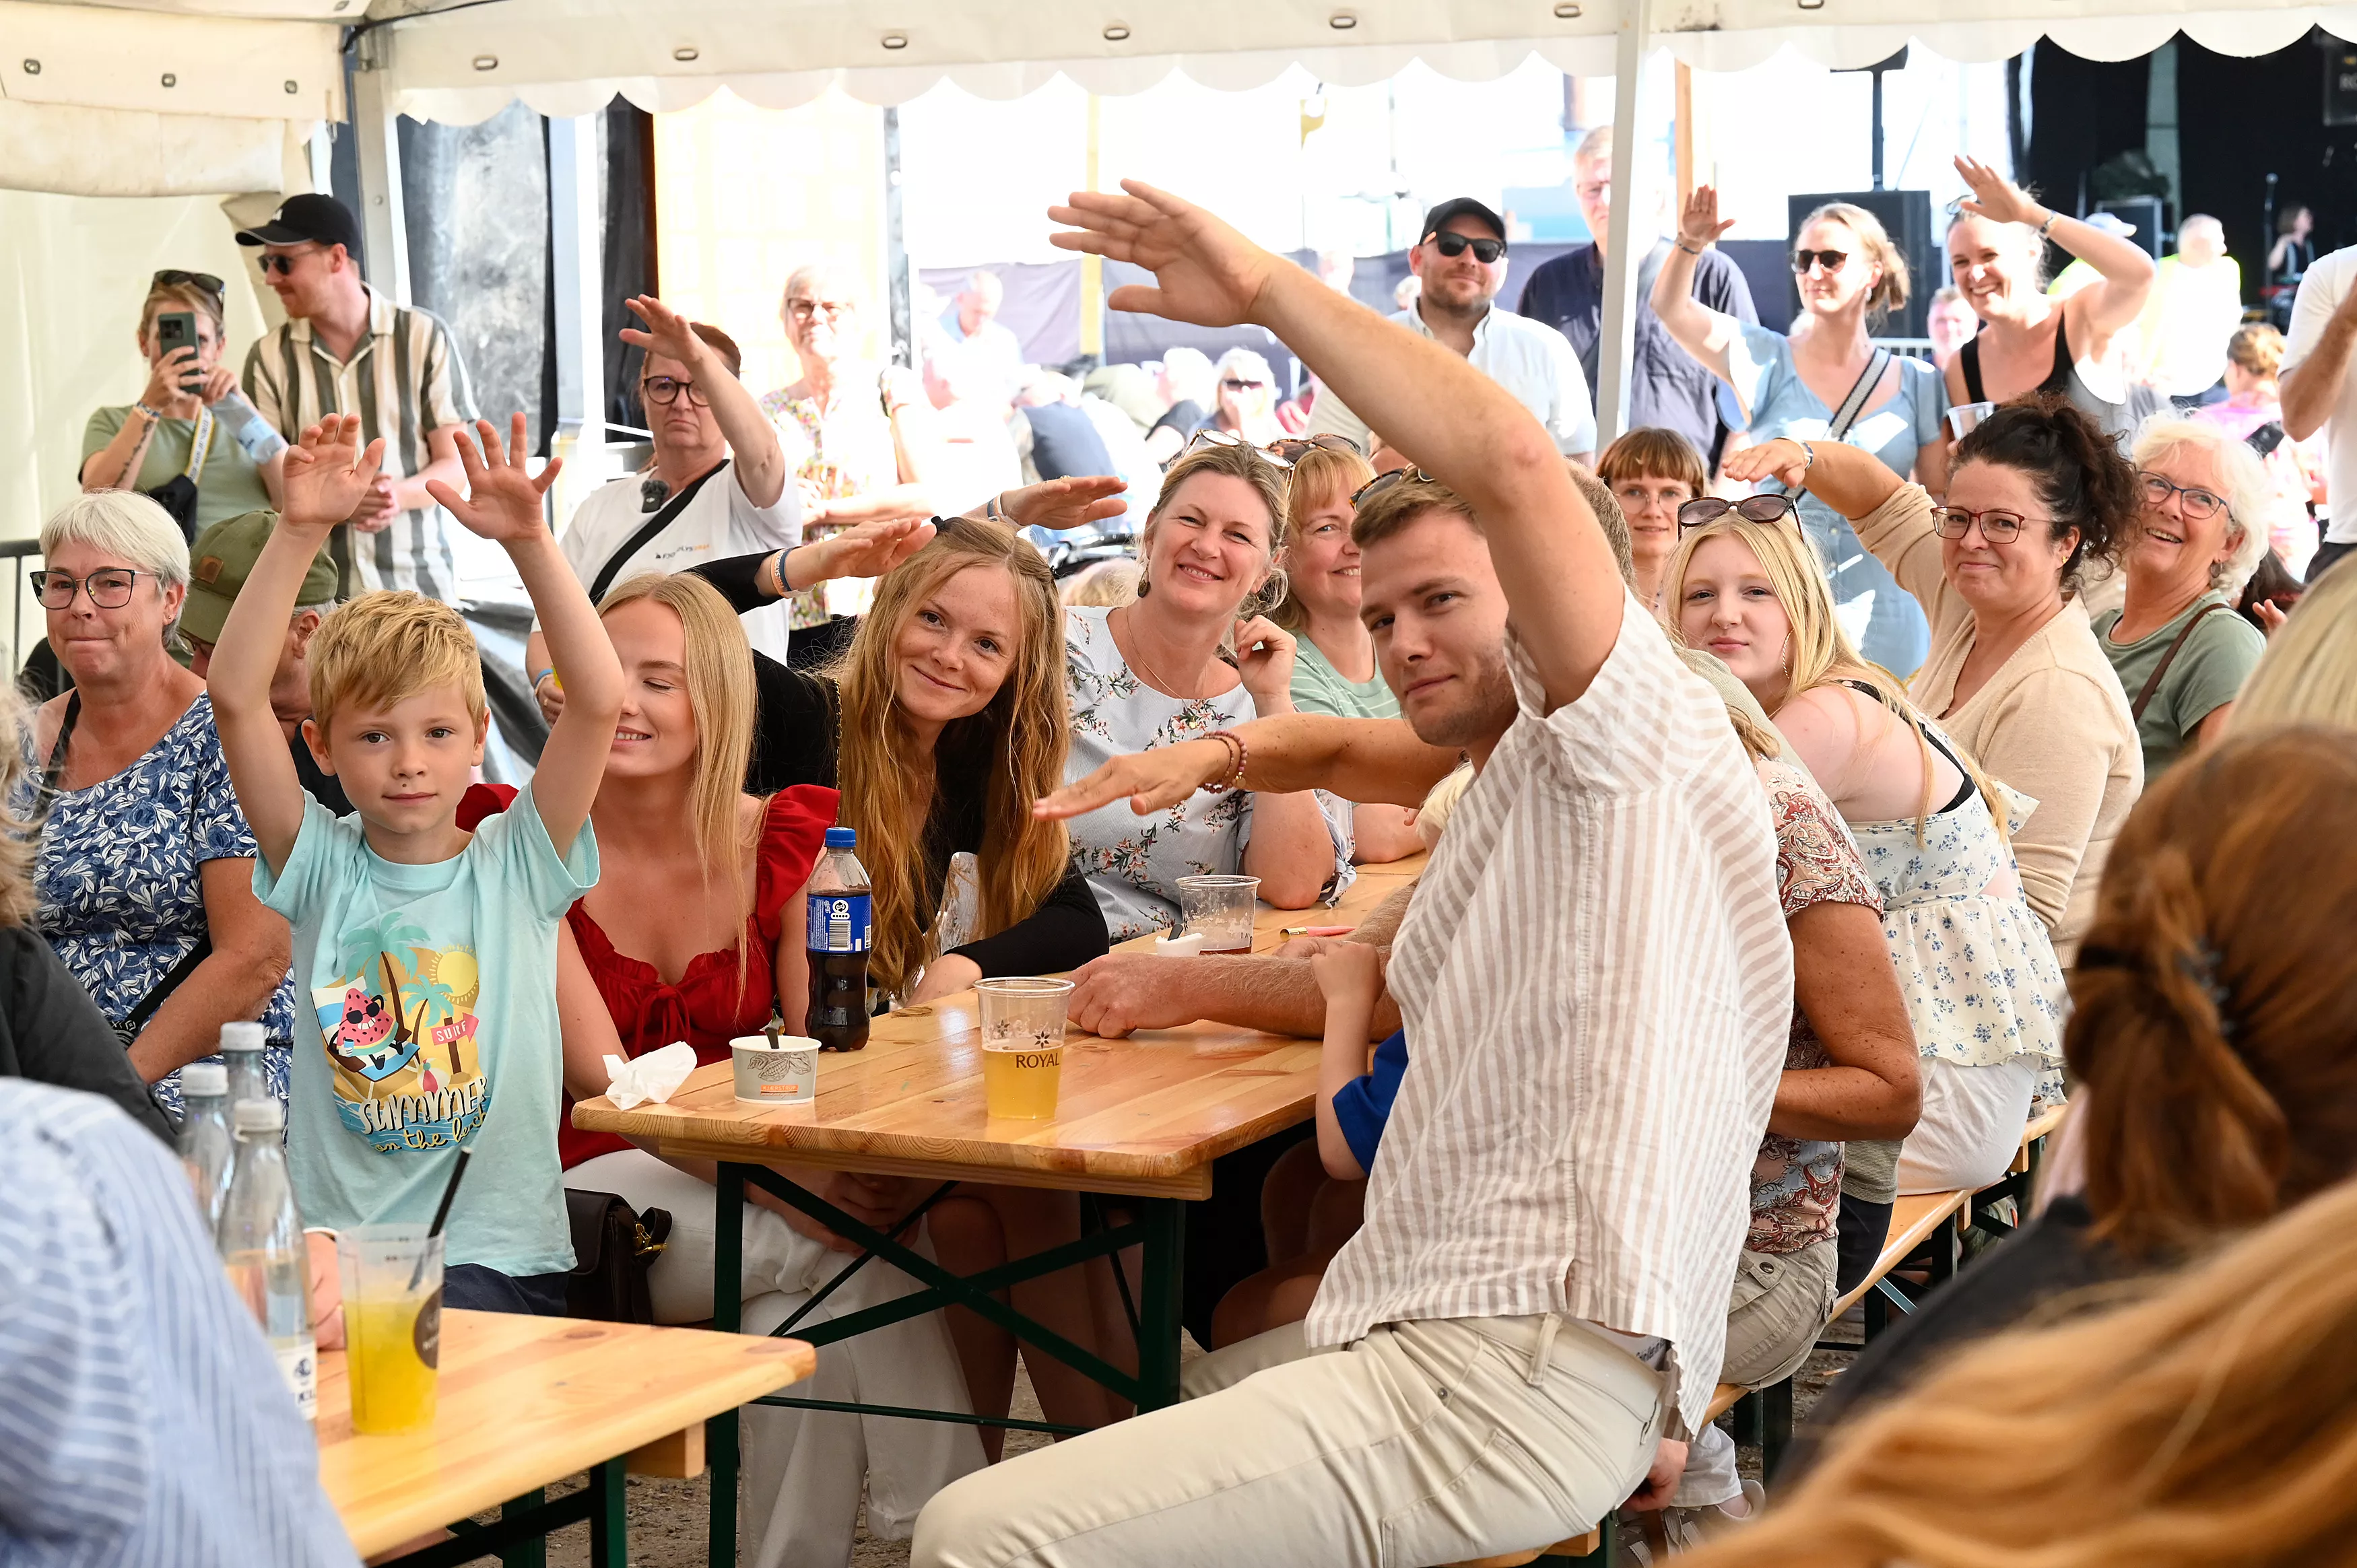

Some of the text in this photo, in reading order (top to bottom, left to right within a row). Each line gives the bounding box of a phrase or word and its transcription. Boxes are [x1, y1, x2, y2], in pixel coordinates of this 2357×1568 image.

[436, 1021, 466, 1042] SURF
[1016, 1052, 1060, 1068] ROYAL
[359, 1077, 487, 1134] SUMMER
[374, 1143, 403, 1153] on
[403, 1129, 449, 1149] the
